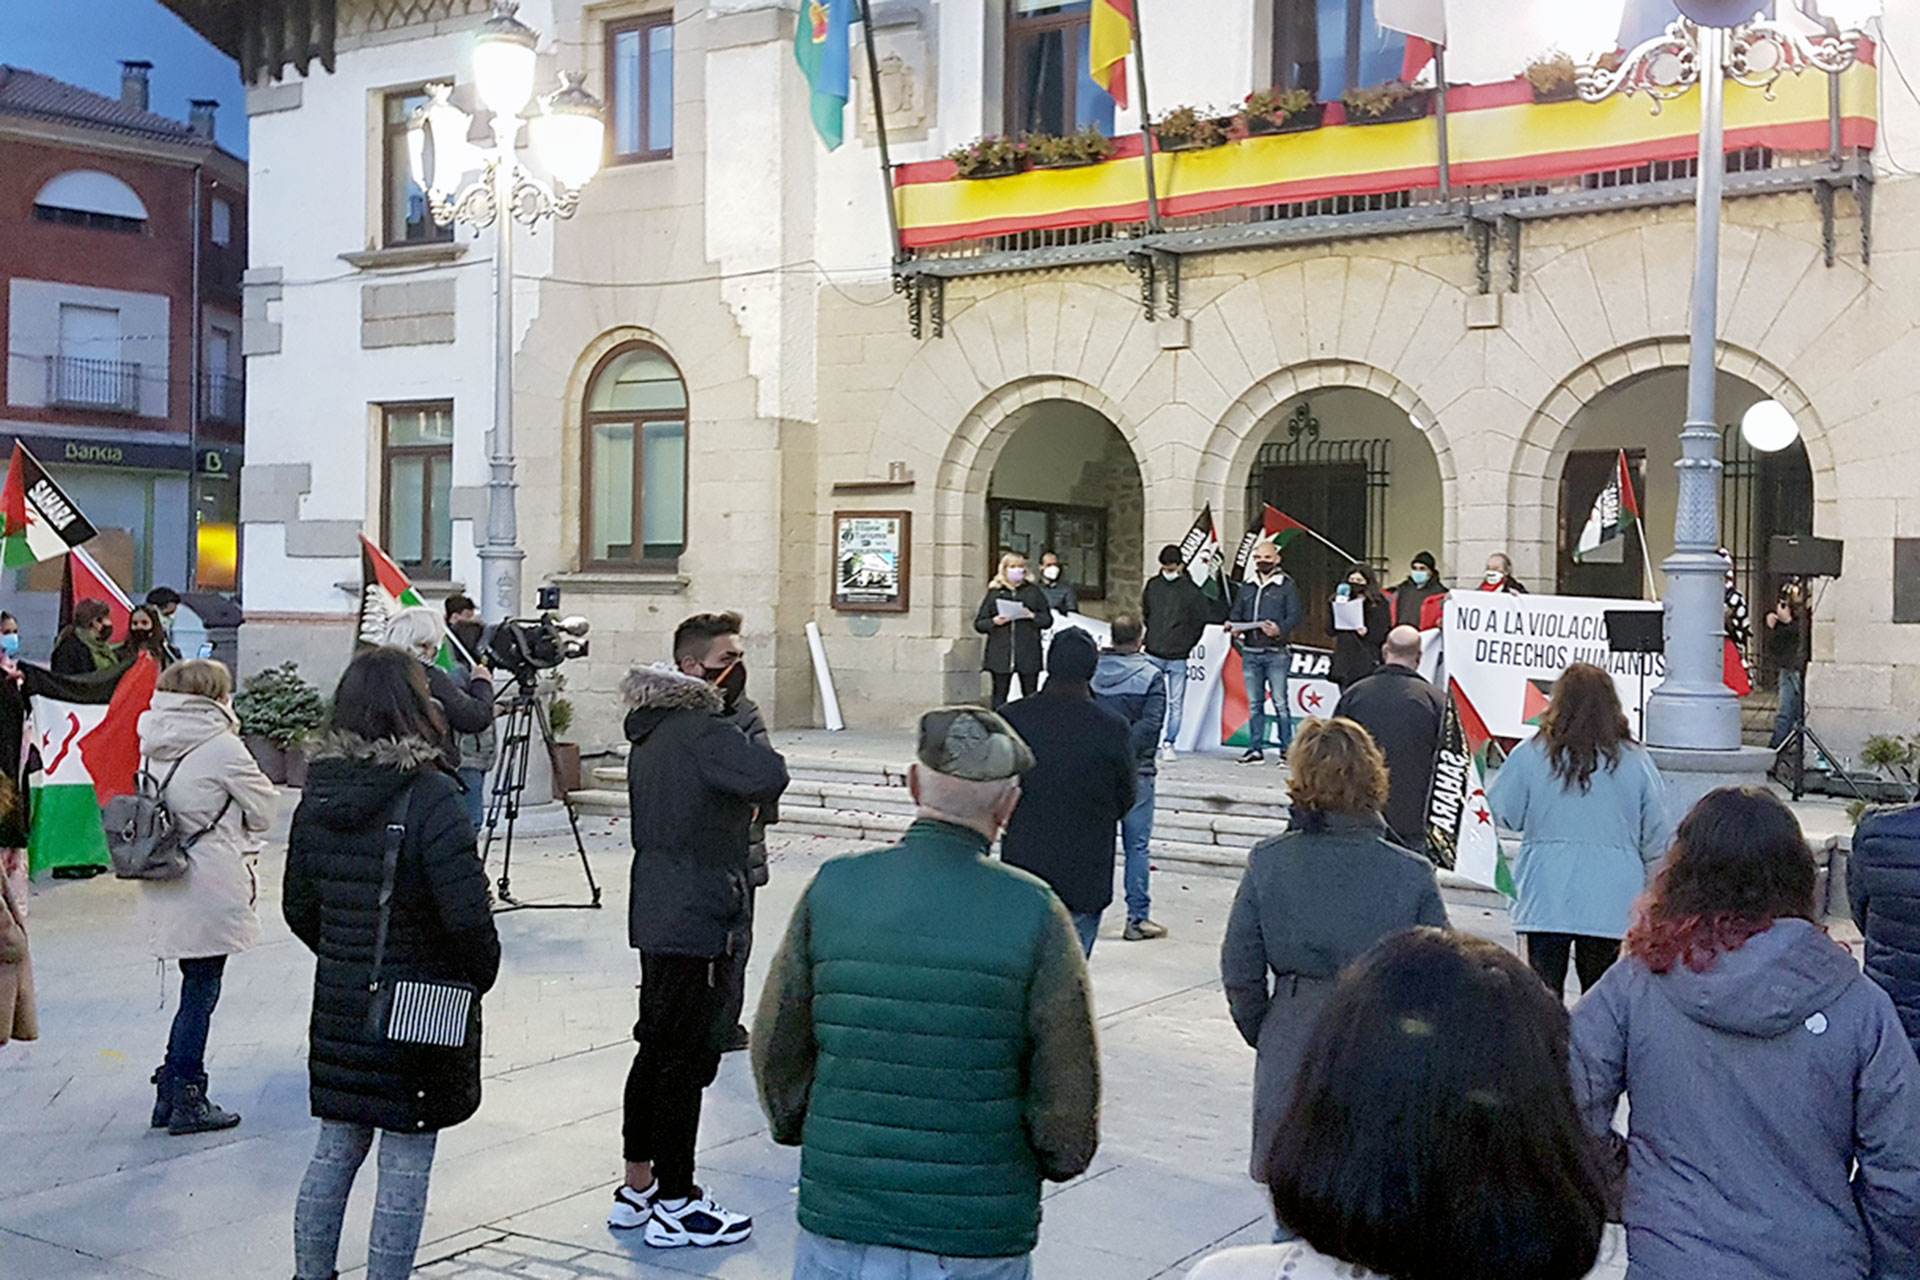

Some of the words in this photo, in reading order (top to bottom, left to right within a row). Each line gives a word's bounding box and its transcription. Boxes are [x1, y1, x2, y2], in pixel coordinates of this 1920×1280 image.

[27, 479, 77, 531] SAHARA
[1457, 606, 1481, 631] NO
[1485, 610, 1498, 633] A
[1504, 611, 1525, 637] LA
[1475, 639, 1567, 669] DERECHOS
